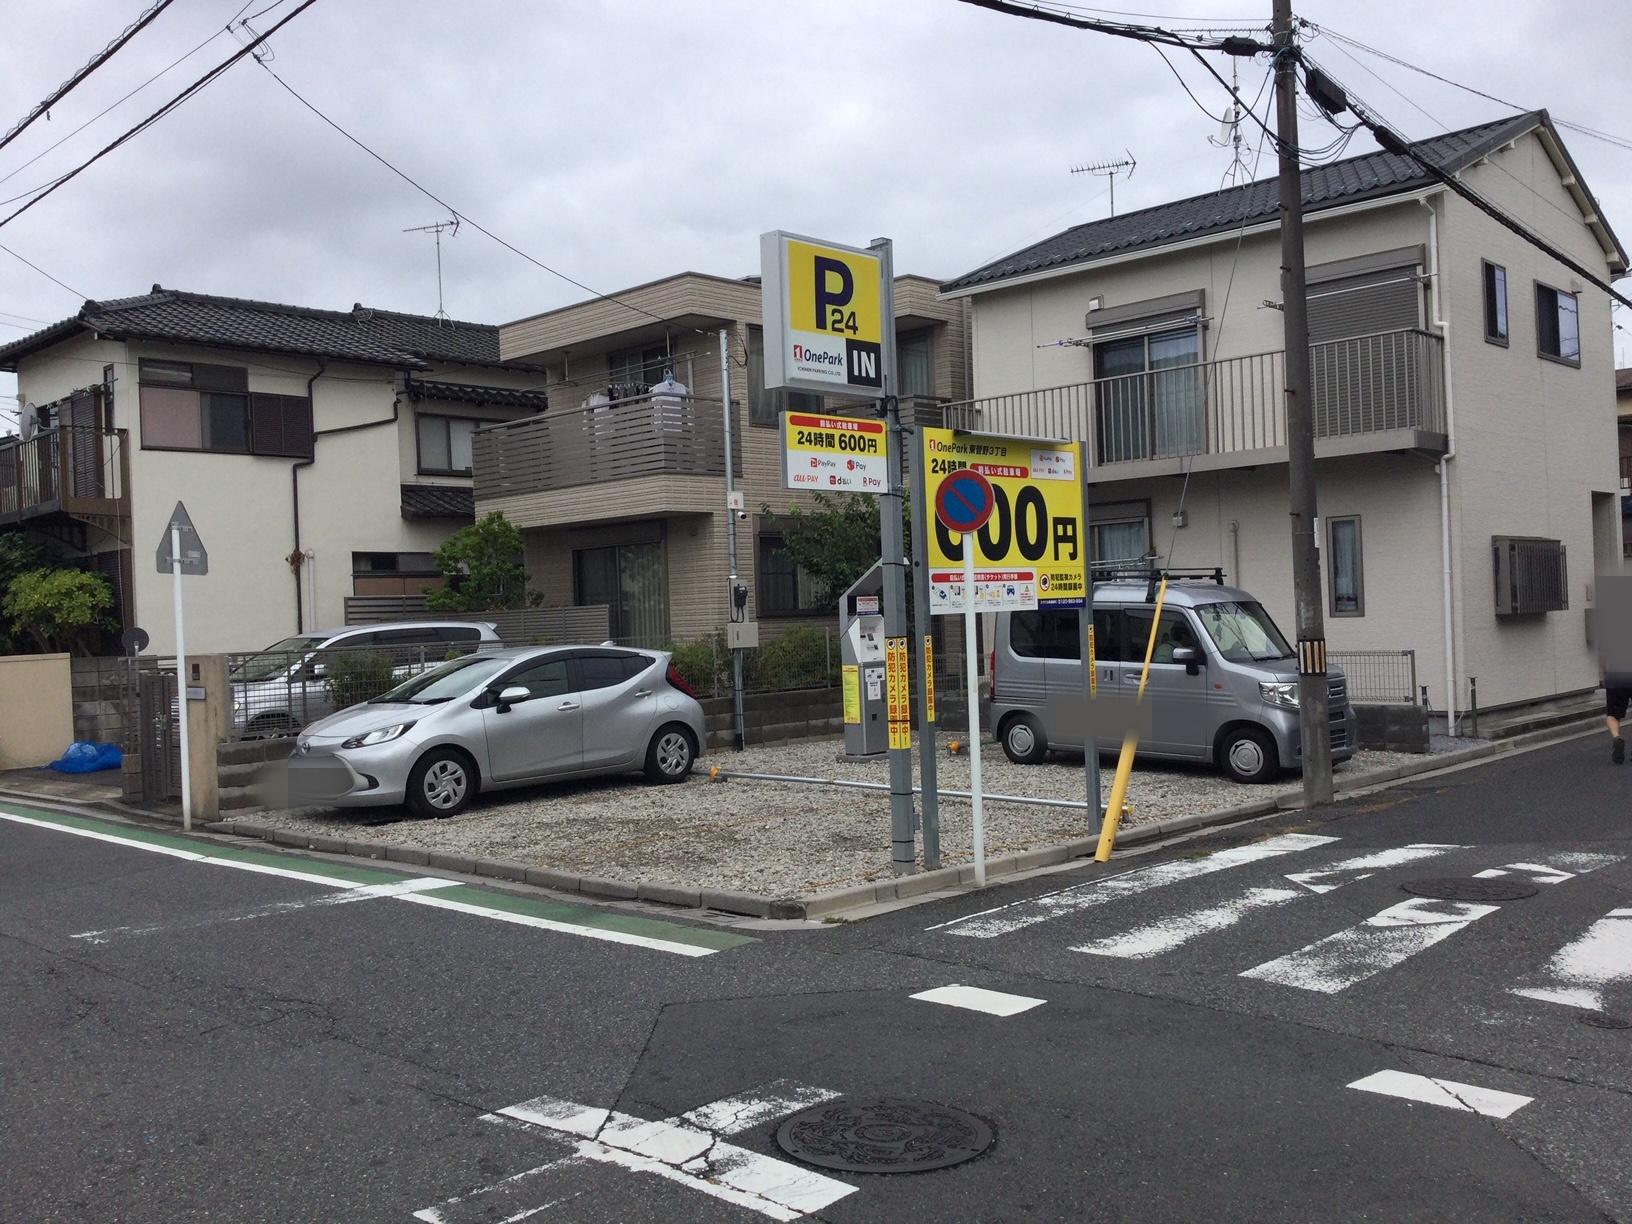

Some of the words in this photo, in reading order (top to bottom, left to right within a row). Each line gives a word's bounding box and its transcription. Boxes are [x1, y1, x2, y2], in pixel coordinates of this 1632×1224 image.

[814, 255, 854, 331] P
[831, 308, 859, 335] 24
[804, 348, 843, 366] OnePark
[852, 349, 876, 379] IN
[797, 430, 836, 449] 24時間
[838, 433, 877, 454] 600円
[937, 441, 968, 455] OnePark
[818, 459, 836, 468] PayPay
[935, 483, 1078, 562] 00円
